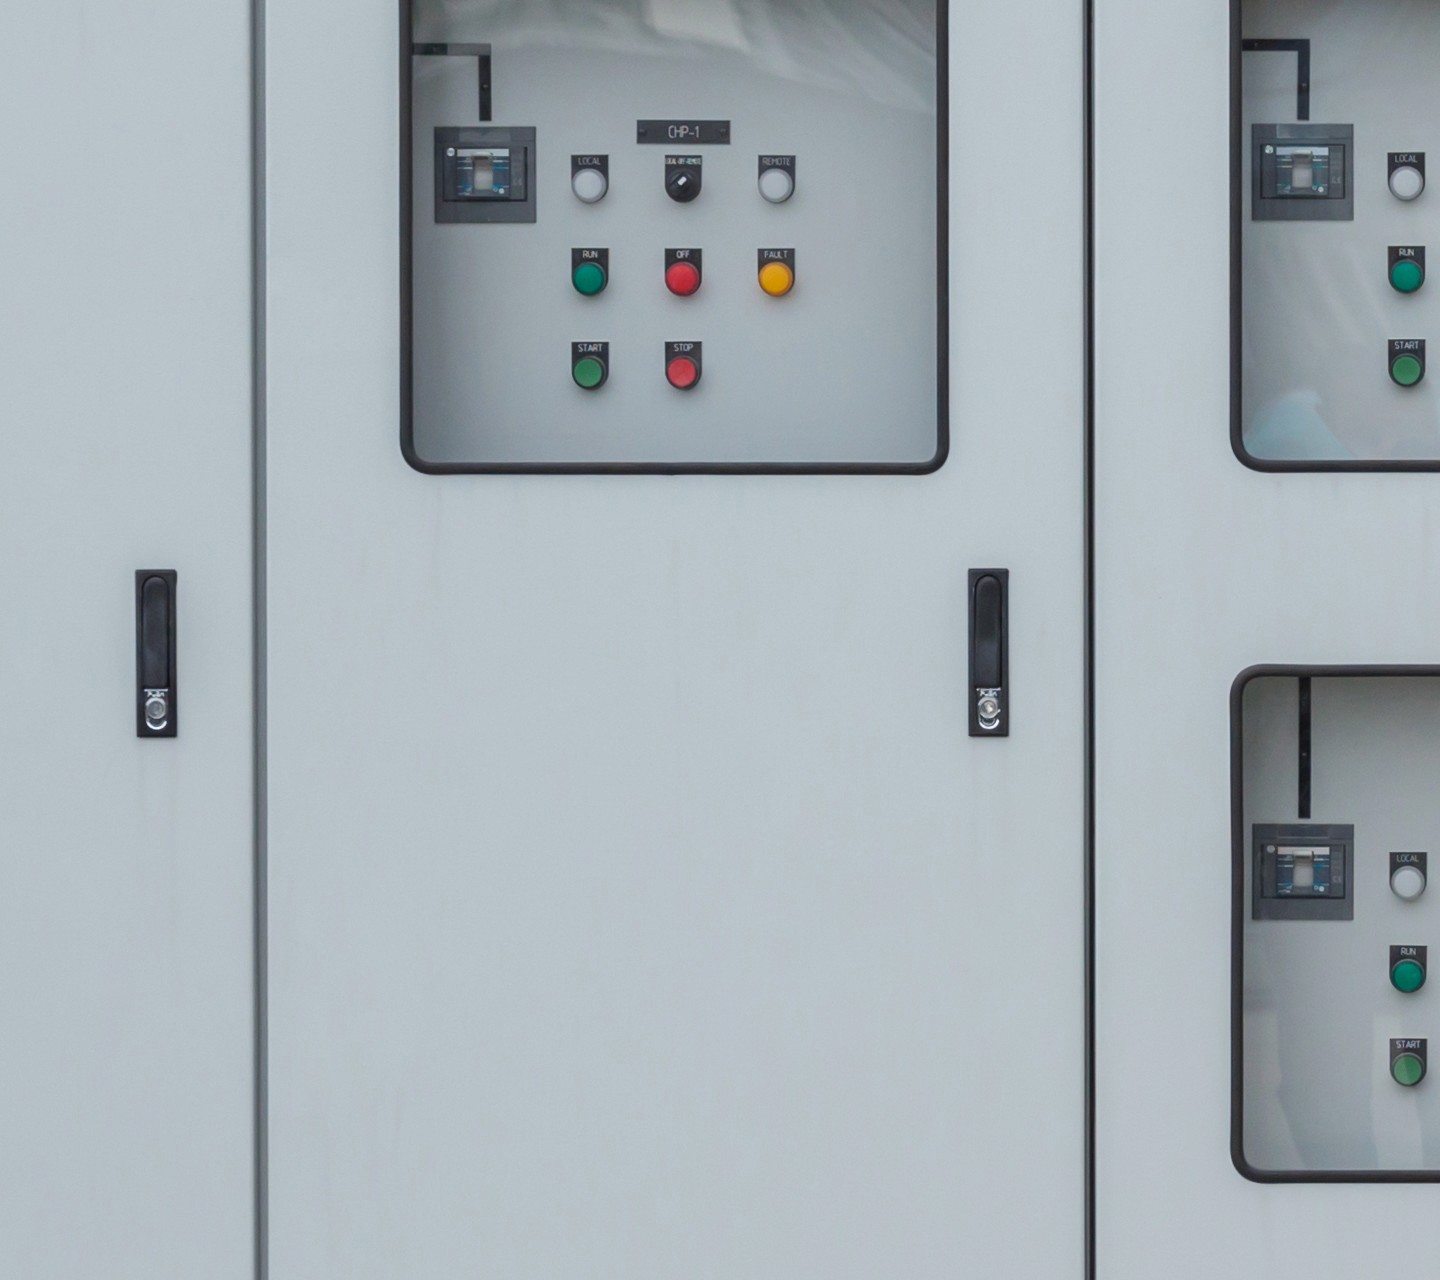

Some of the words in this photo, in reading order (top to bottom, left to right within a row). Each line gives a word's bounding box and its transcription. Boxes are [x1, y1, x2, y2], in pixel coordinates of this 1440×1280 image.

[668, 125, 699, 139] CHP-1
[578, 157, 601, 166] LOCAL
[762, 157, 790, 166] REMOTE
[1394, 154, 1418, 163] LOCAL
[582, 250, 598, 259] RUN
[676, 250, 690, 259] OFF
[764, 251, 788, 259] FAULT
[1399, 248, 1414, 257] RUN
[578, 344, 602, 353] START
[673, 344, 693, 352] STOP
[1394, 341, 1419, 350] START
[1396, 854, 1419, 862] LOCAL
[1400, 947, 1416, 956] RUN
[1395, 1040, 1420, 1049] START
